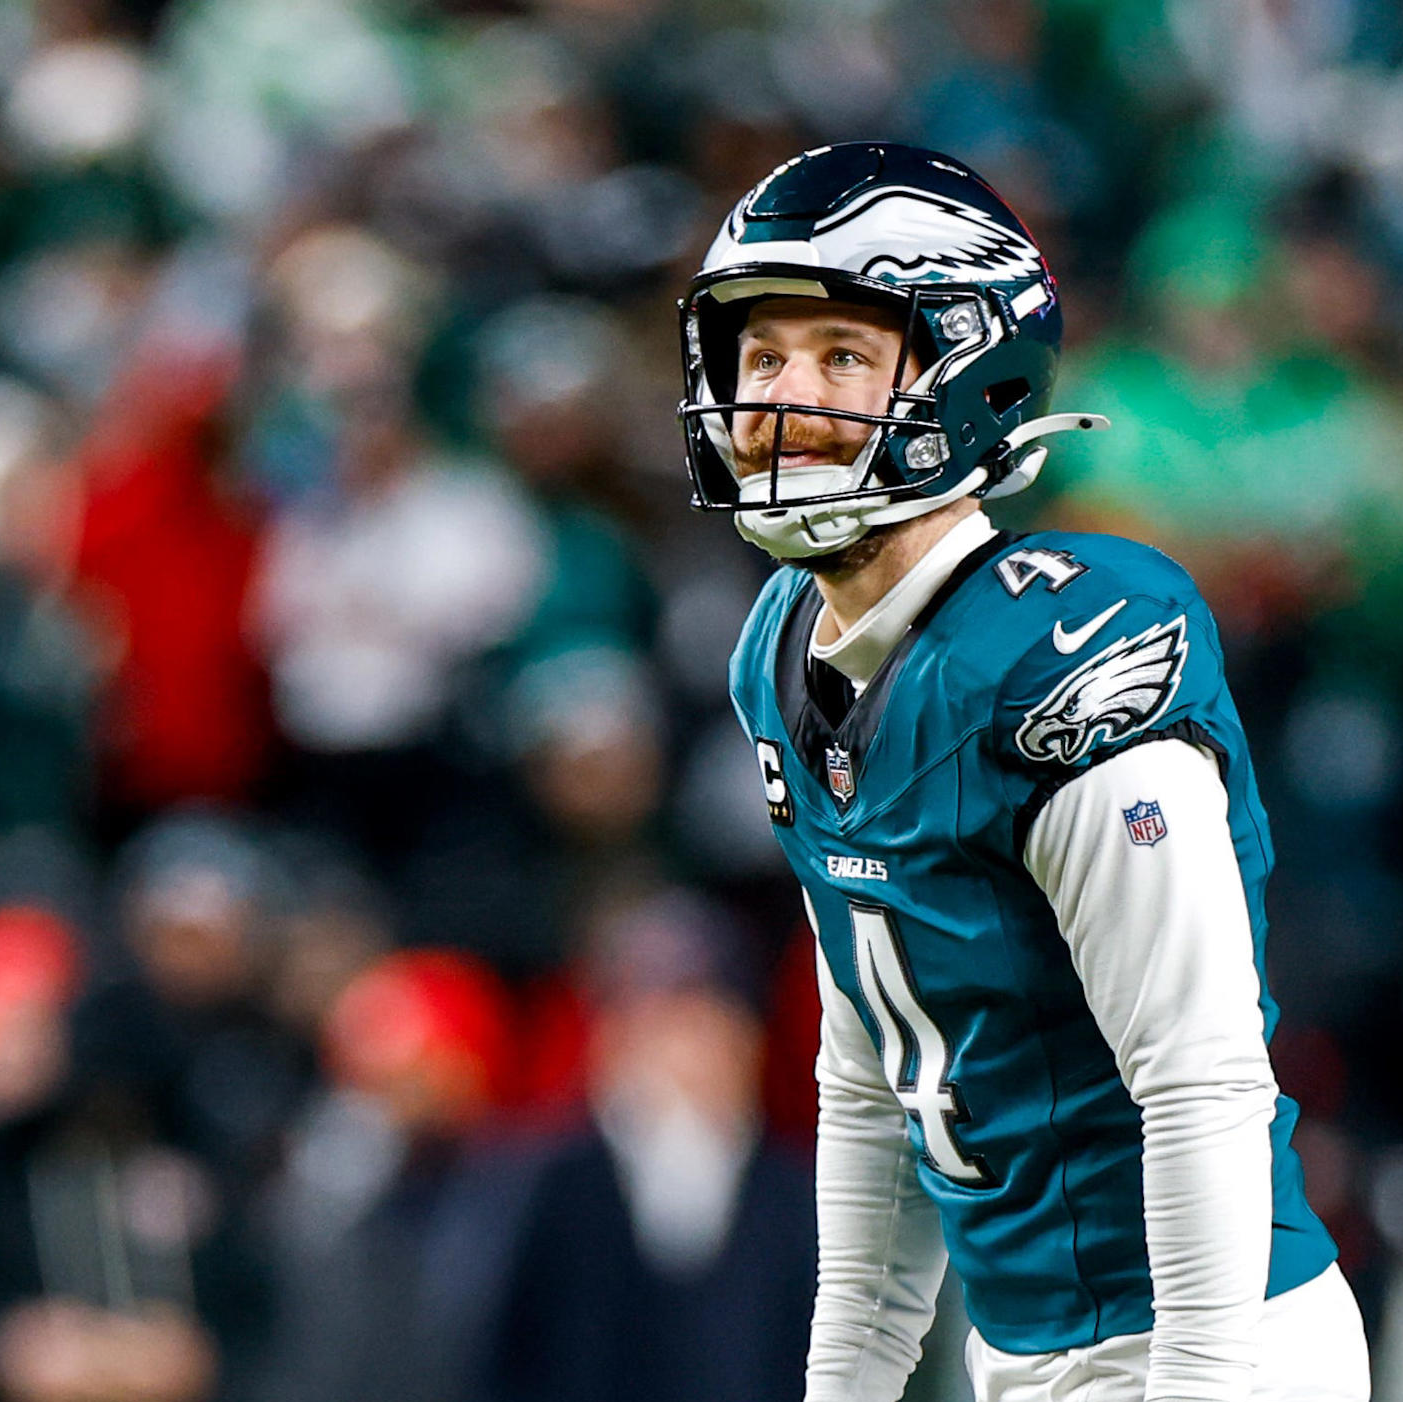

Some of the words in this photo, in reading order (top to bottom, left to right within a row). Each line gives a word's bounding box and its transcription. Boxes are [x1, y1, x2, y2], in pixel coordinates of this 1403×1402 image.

[994, 549, 1087, 598] 4
[756, 740, 786, 804] C
[1130, 817, 1164, 841] NFL
[826, 855, 888, 882] EAGLES
[849, 903, 995, 1185] 4
